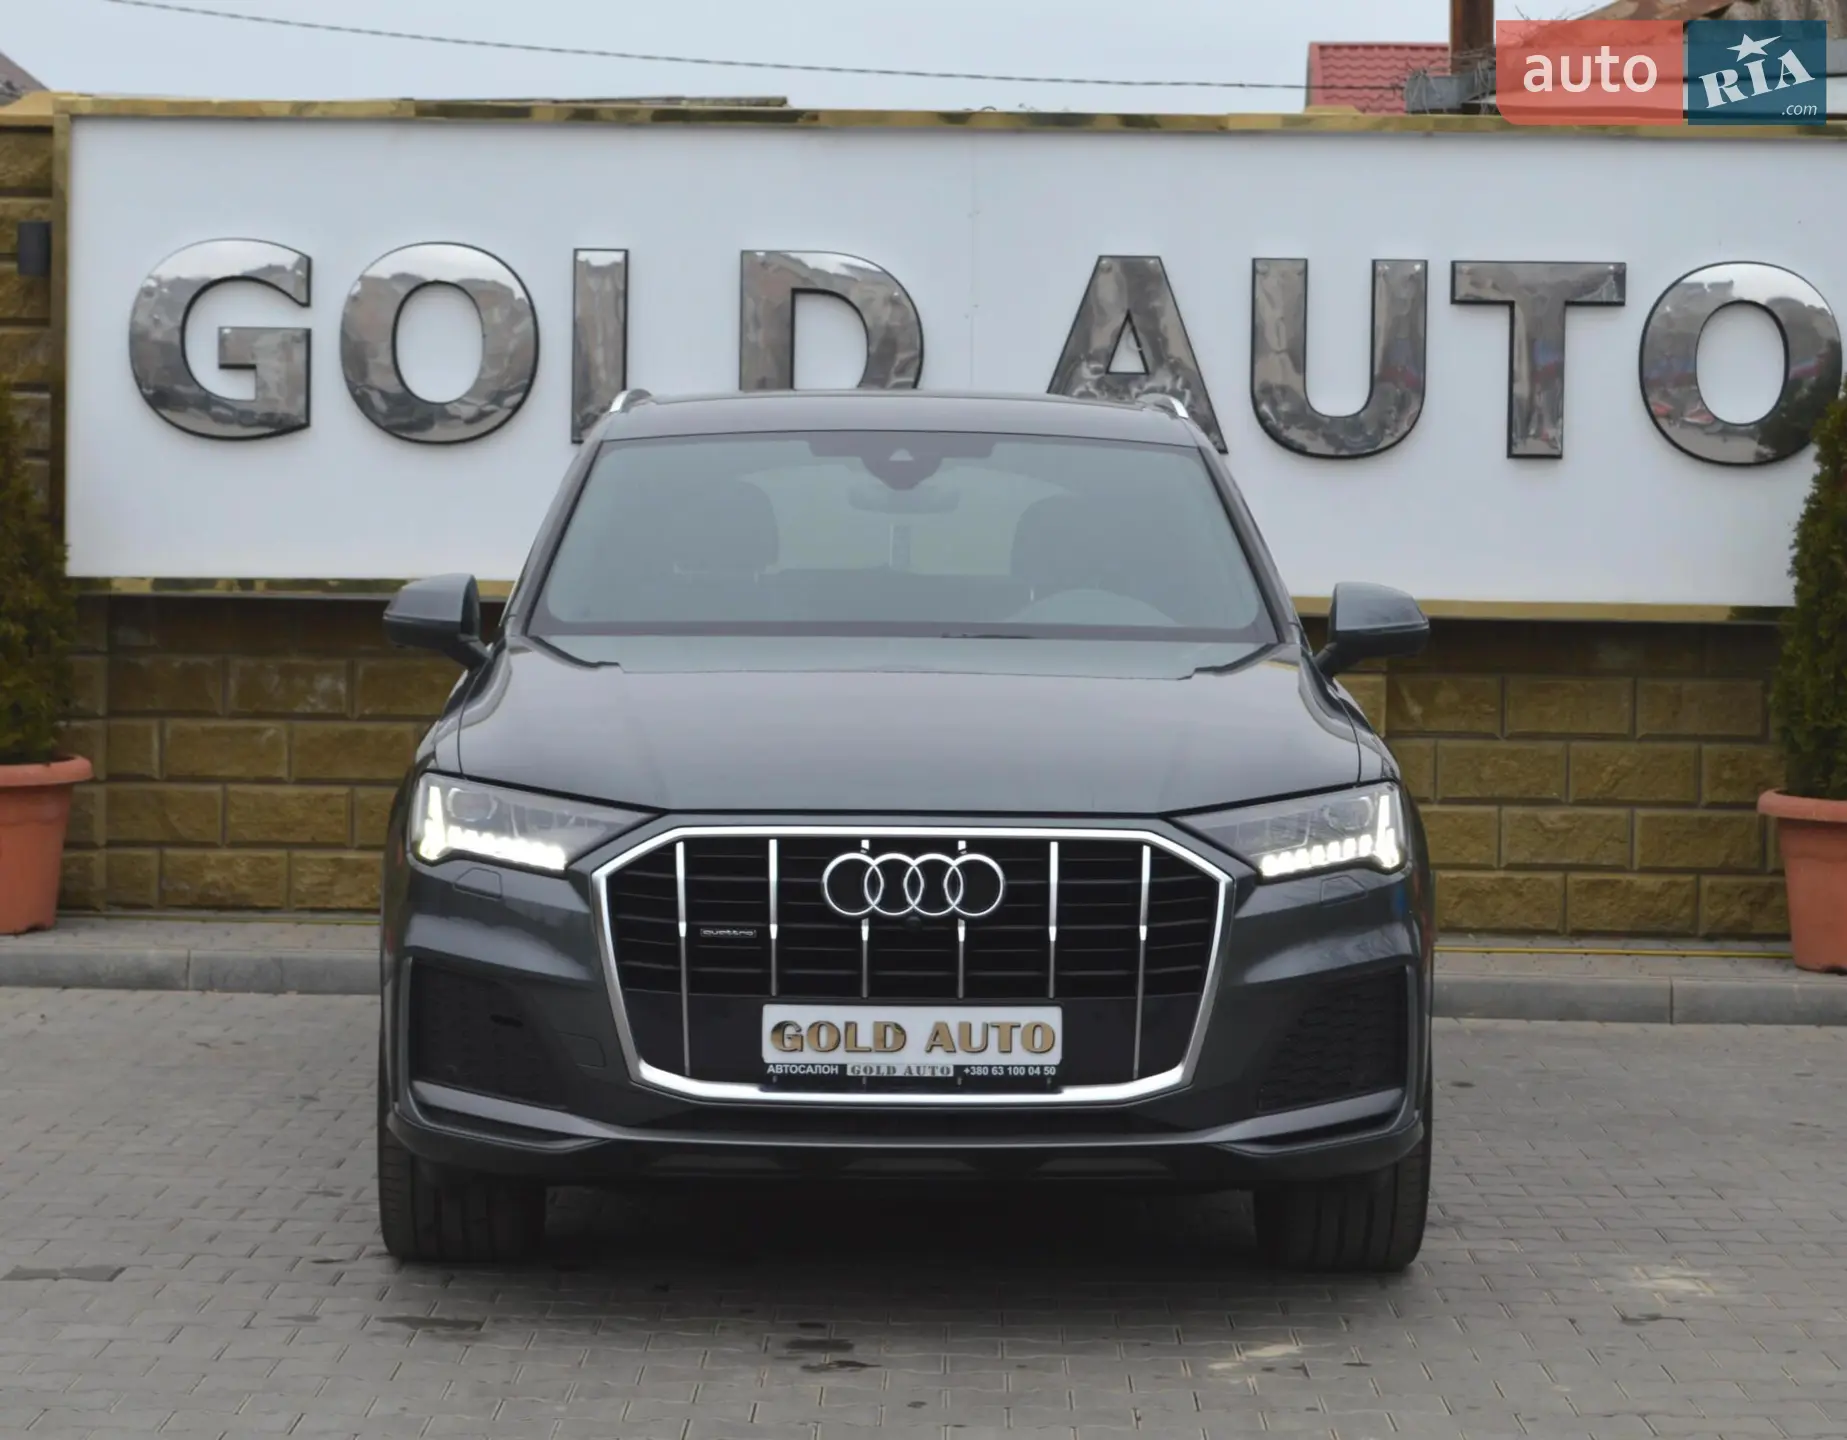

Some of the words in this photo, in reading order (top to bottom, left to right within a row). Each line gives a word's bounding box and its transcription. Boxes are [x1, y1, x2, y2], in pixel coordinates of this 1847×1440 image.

[1046, 255, 1843, 466] AUTO
[770, 1020, 907, 1053] GOLD
[924, 1021, 1056, 1054] AUTO
[766, 1063, 839, 1075] АВТОСАЛОН
[850, 1064, 897, 1076] GOLD
[903, 1065, 951, 1076] AUTO
[963, 1065, 989, 1076] +380
[991, 1065, 1004, 1076] 63
[1007, 1065, 1025, 1076] 100
[1028, 1065, 1041, 1076] 04
[1043, 1065, 1057, 1076] 50
